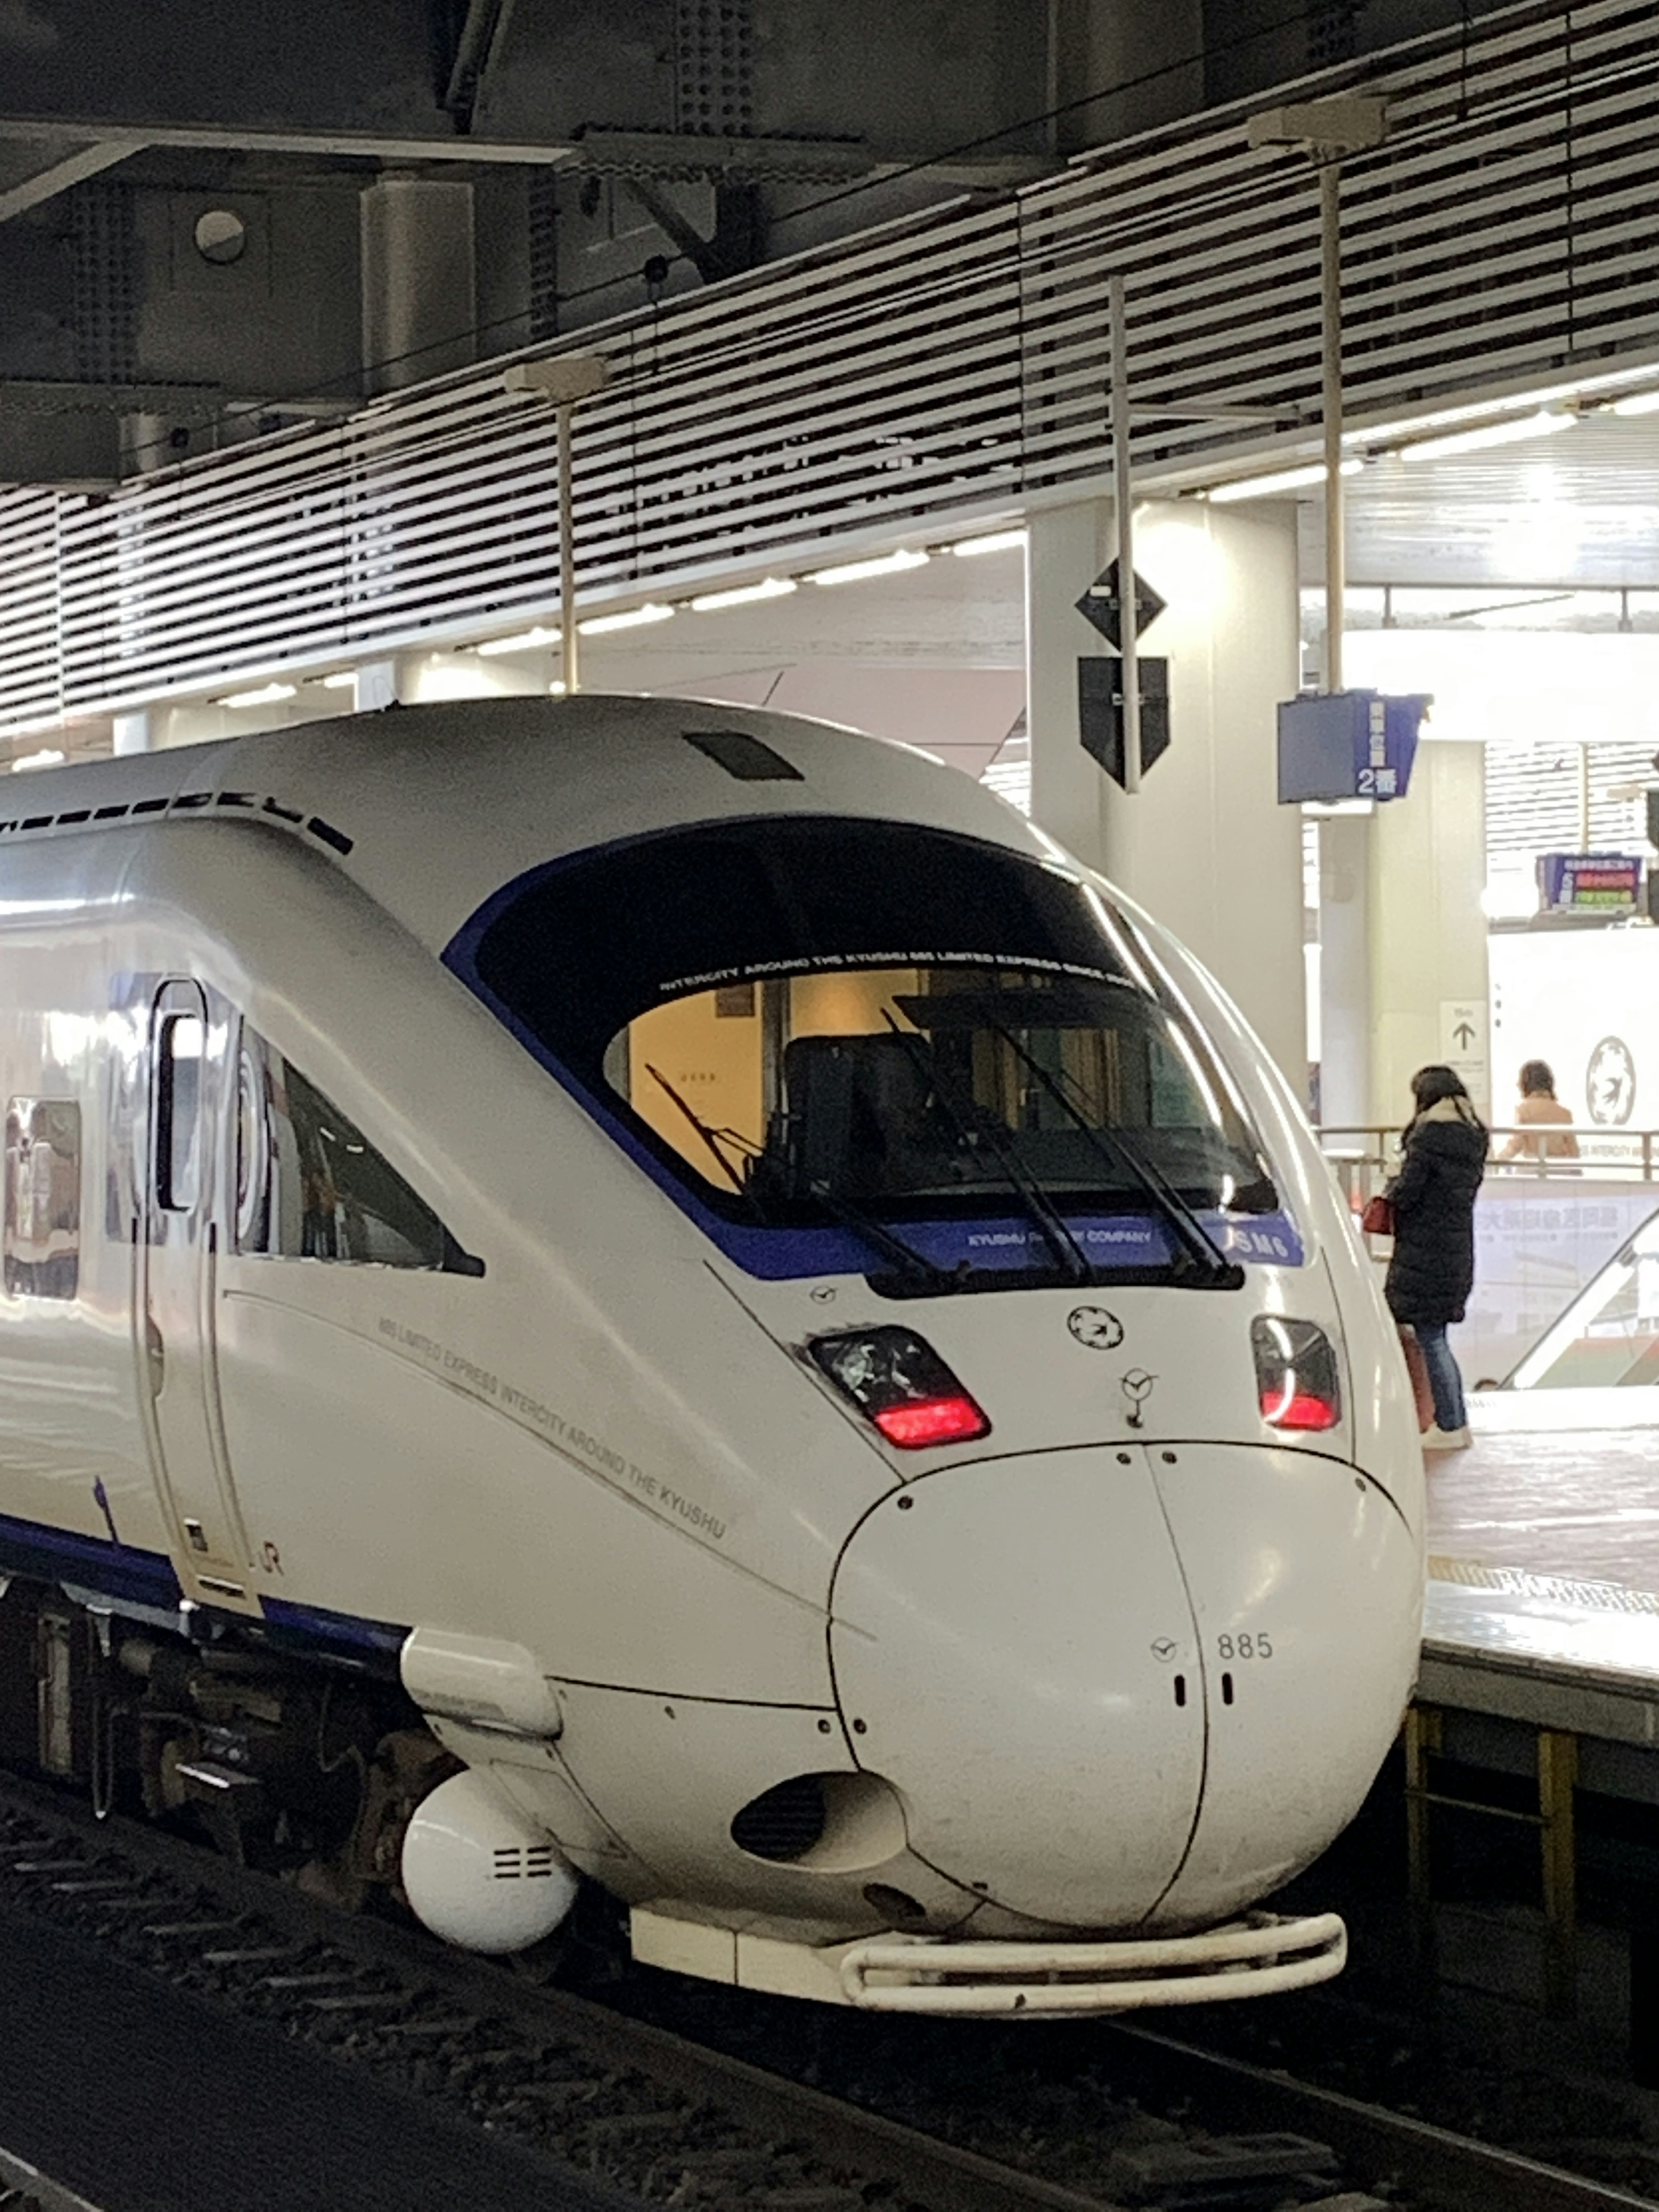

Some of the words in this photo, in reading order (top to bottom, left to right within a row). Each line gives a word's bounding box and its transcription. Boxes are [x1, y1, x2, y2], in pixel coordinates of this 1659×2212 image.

[1359, 769, 1397, 794] 2番
[659, 967, 738, 991] INTERCITY
[744, 958, 810, 974] AROUND
[812, 955, 843, 965] THE
[1087, 1230, 1151, 1243] COMPANY
[444, 1350, 497, 1394] EXPRESS
[501, 1384, 567, 1435] INTERCITY
[567, 1427, 625, 1474] AROUND
[629, 1463, 657, 1496] THE
[659, 1485, 727, 1539] KYUSHU
[1217, 1633, 1273, 1659] 885
